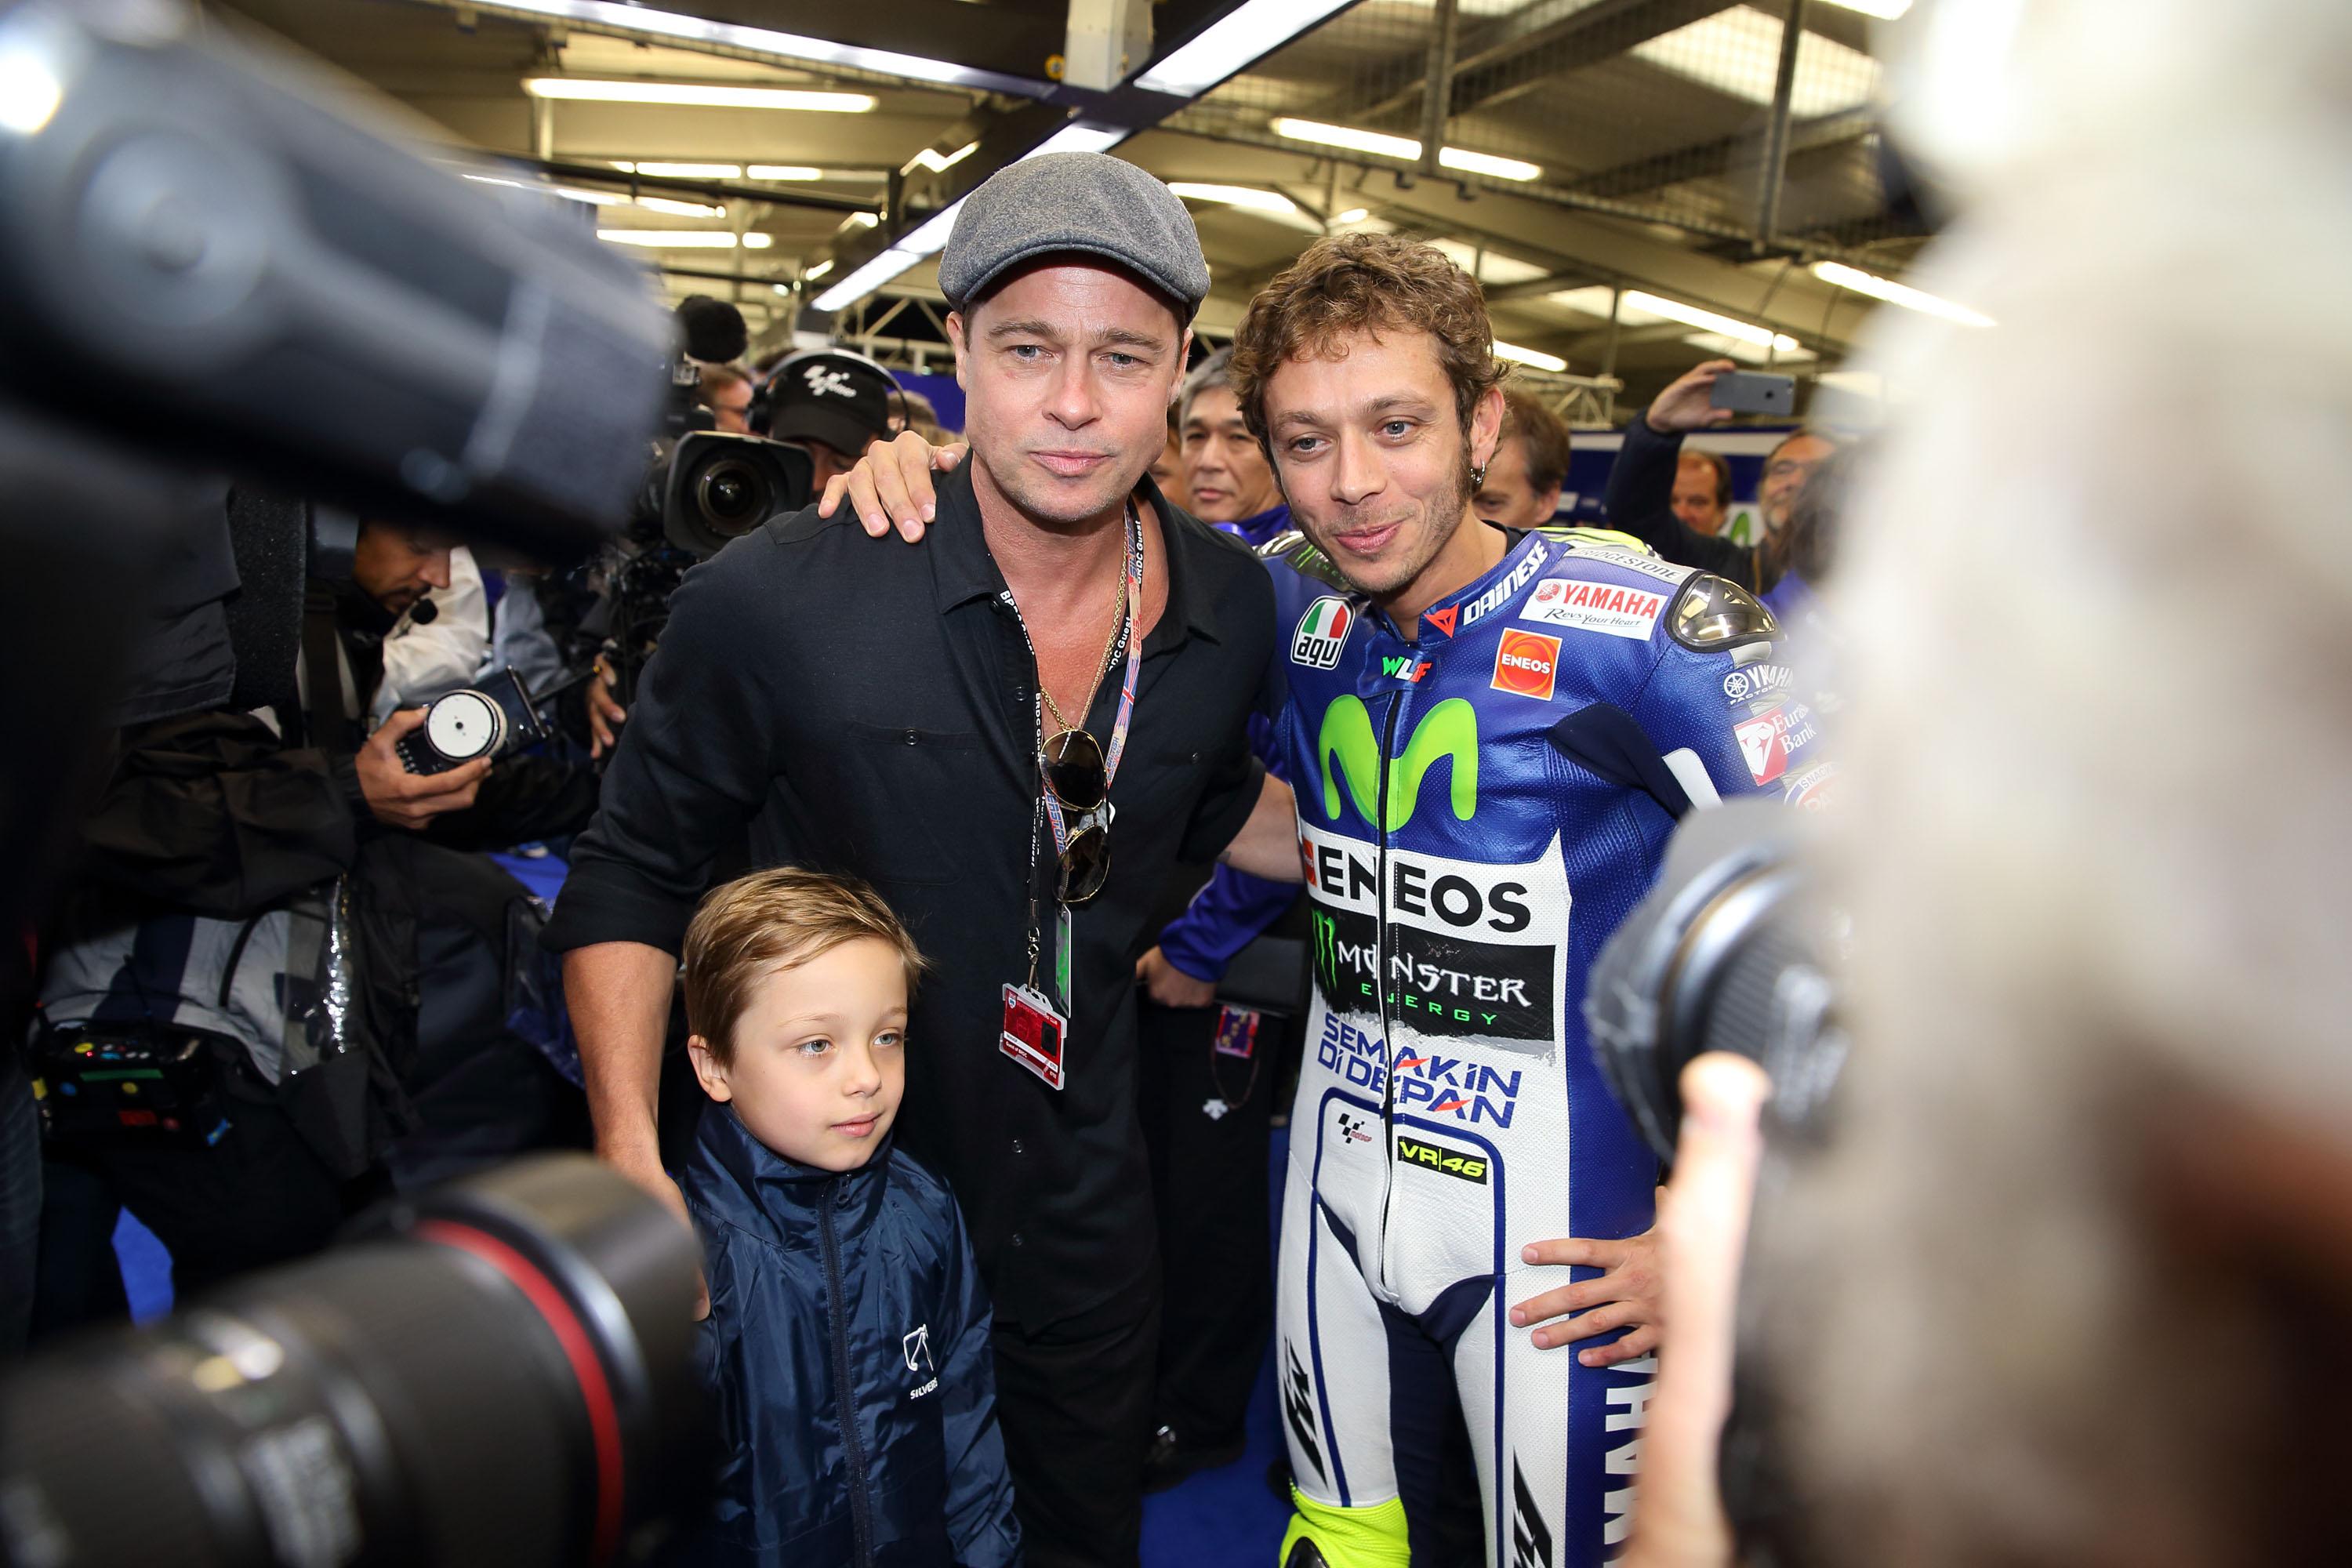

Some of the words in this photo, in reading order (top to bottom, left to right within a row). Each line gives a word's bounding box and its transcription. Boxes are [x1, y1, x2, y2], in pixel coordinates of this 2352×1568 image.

[1563, 583, 1660, 619] YAMAHA
[1382, 656, 1432, 683] WLF
[1501, 653, 1551, 674] ENEOS
[1778, 720, 1817, 756] Bank
[1318, 844, 1531, 933] ENEOS
